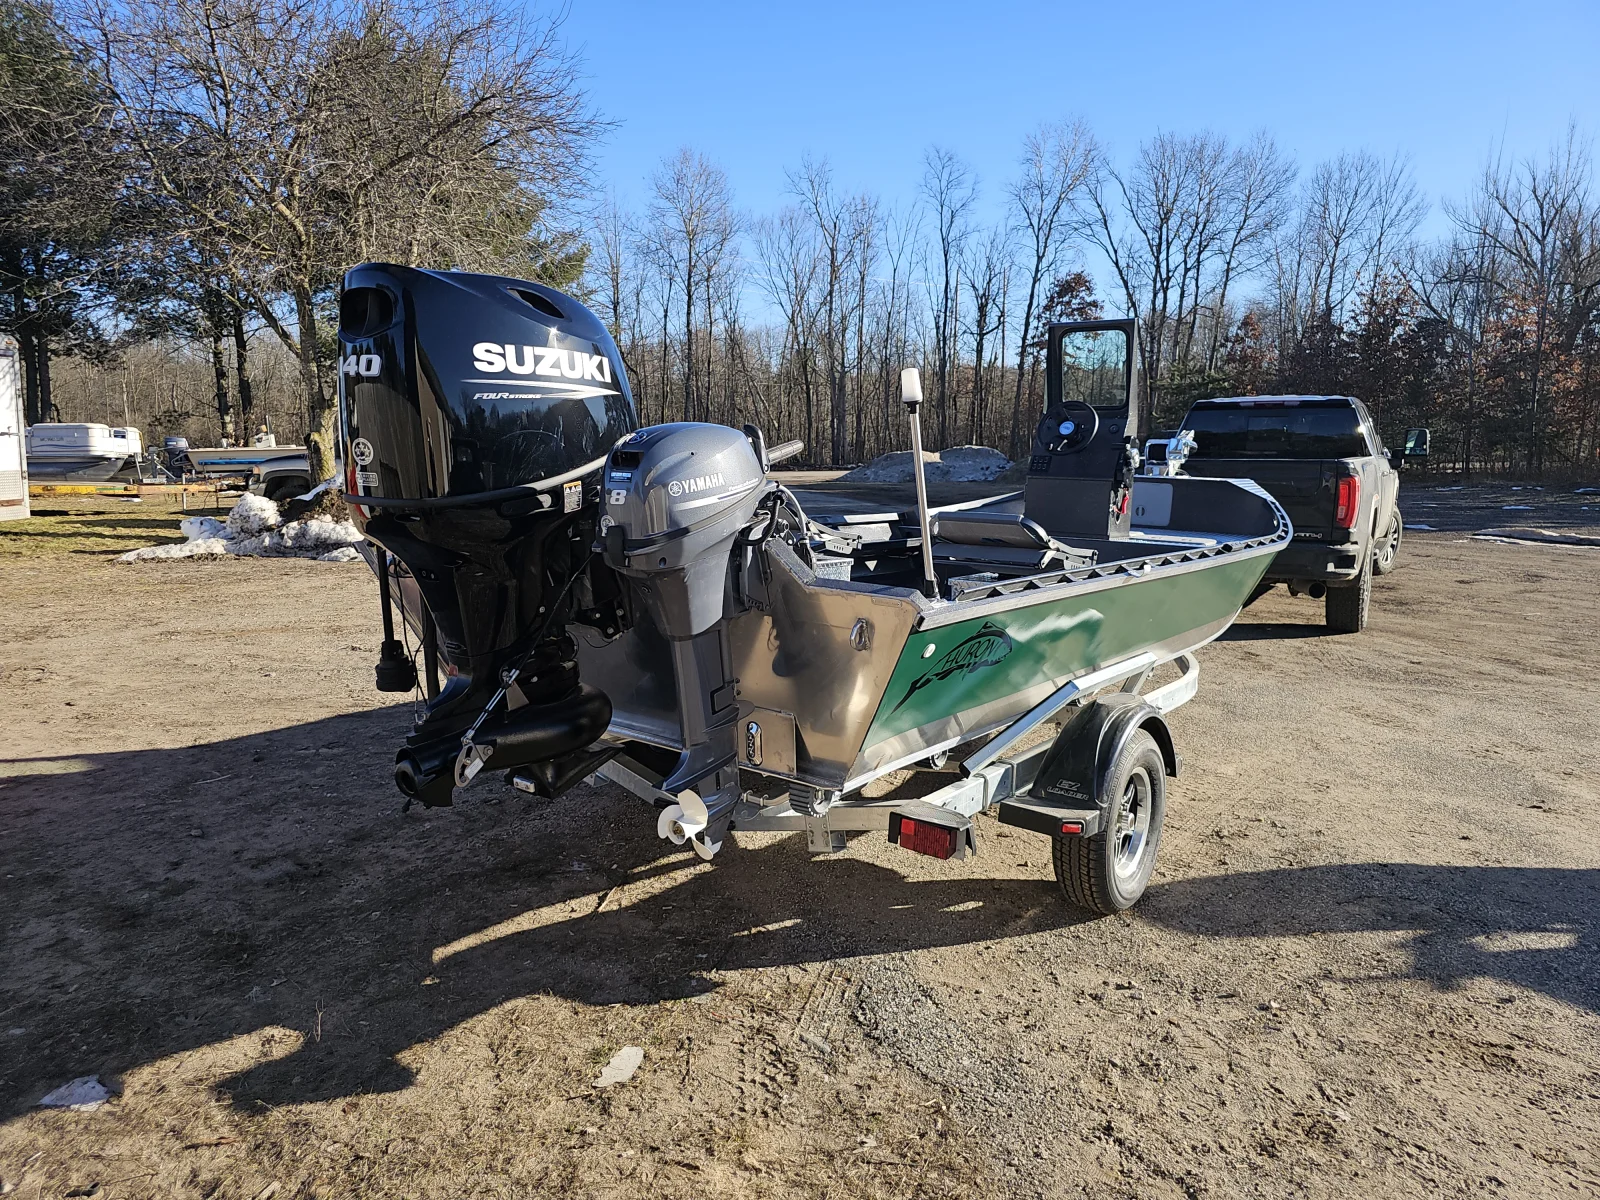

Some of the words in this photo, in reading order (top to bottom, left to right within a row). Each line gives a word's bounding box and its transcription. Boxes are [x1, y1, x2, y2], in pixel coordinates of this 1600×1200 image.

[472, 342, 611, 383] SUZUKI
[682, 473, 725, 494] YAMAHA
[610, 490, 627, 505] 8
[941, 639, 999, 670] HURON
[1046, 786, 1090, 801] LOADER
